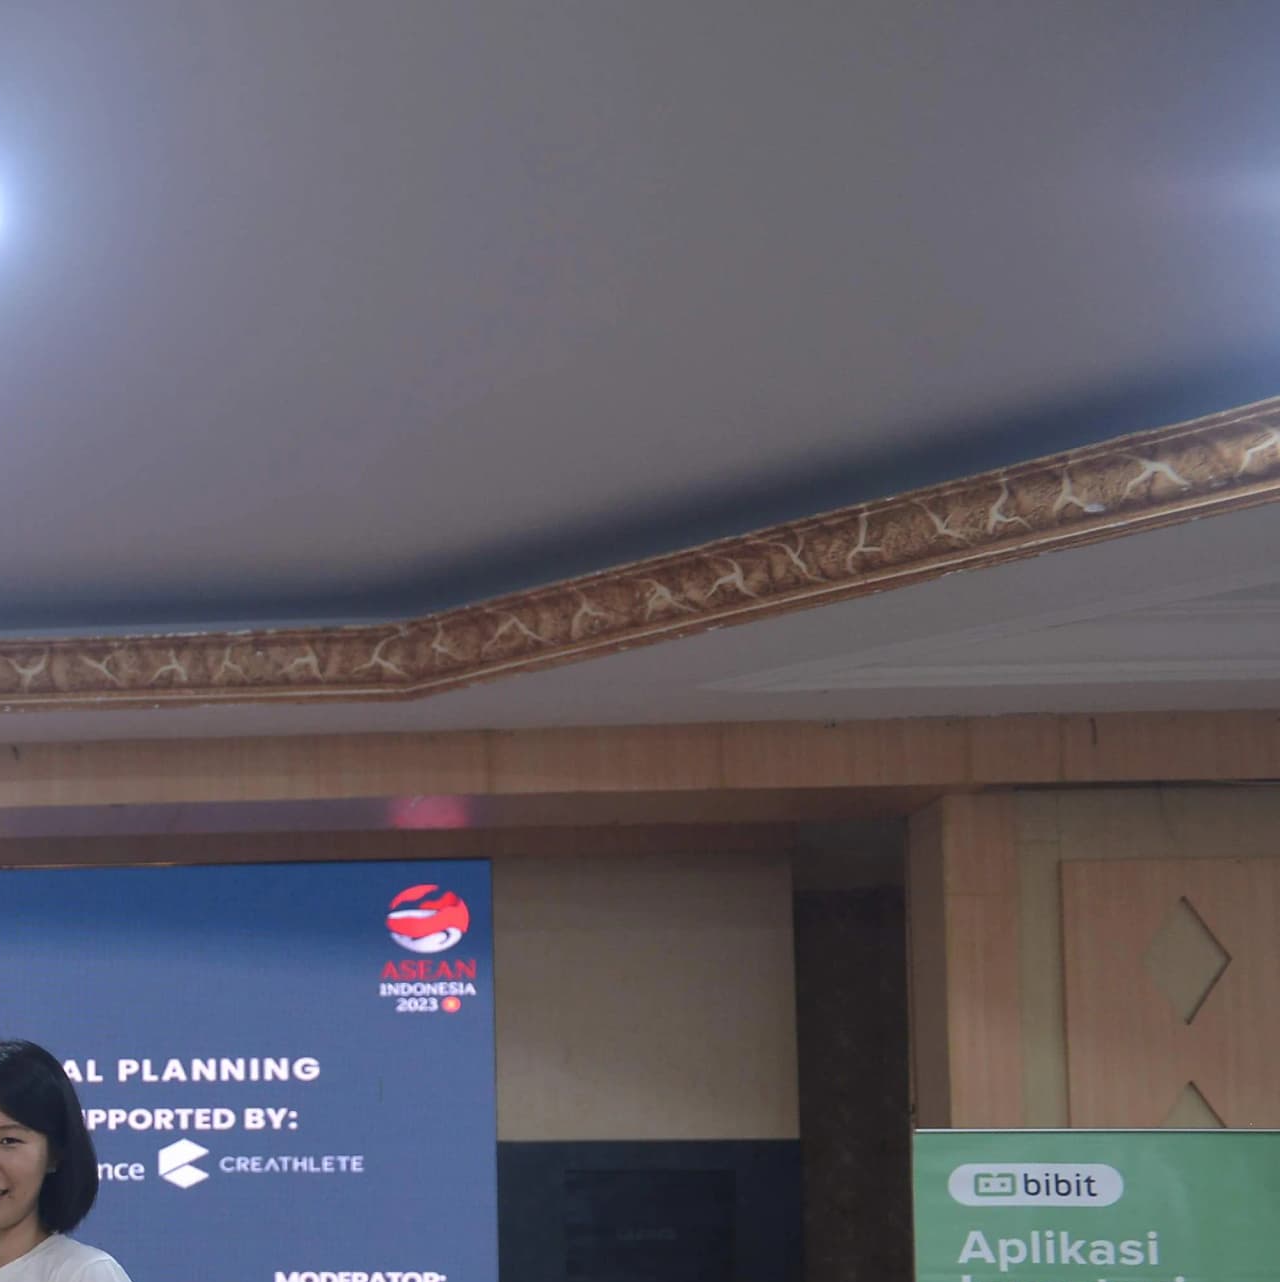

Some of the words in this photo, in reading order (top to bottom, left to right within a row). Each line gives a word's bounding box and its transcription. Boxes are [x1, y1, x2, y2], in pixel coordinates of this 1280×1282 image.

[381, 959, 477, 981] ASEAN
[380, 981, 477, 997] INDONESIA
[396, 997, 439, 1012] 2023
[118, 1058, 321, 1082] PLANNING
[244, 1108, 298, 1130] BY:
[219, 1155, 365, 1173] CREATHLETE
[1023, 1174, 1099, 1198] bibit
[958, 1230, 1160, 1272] Aplikasi
